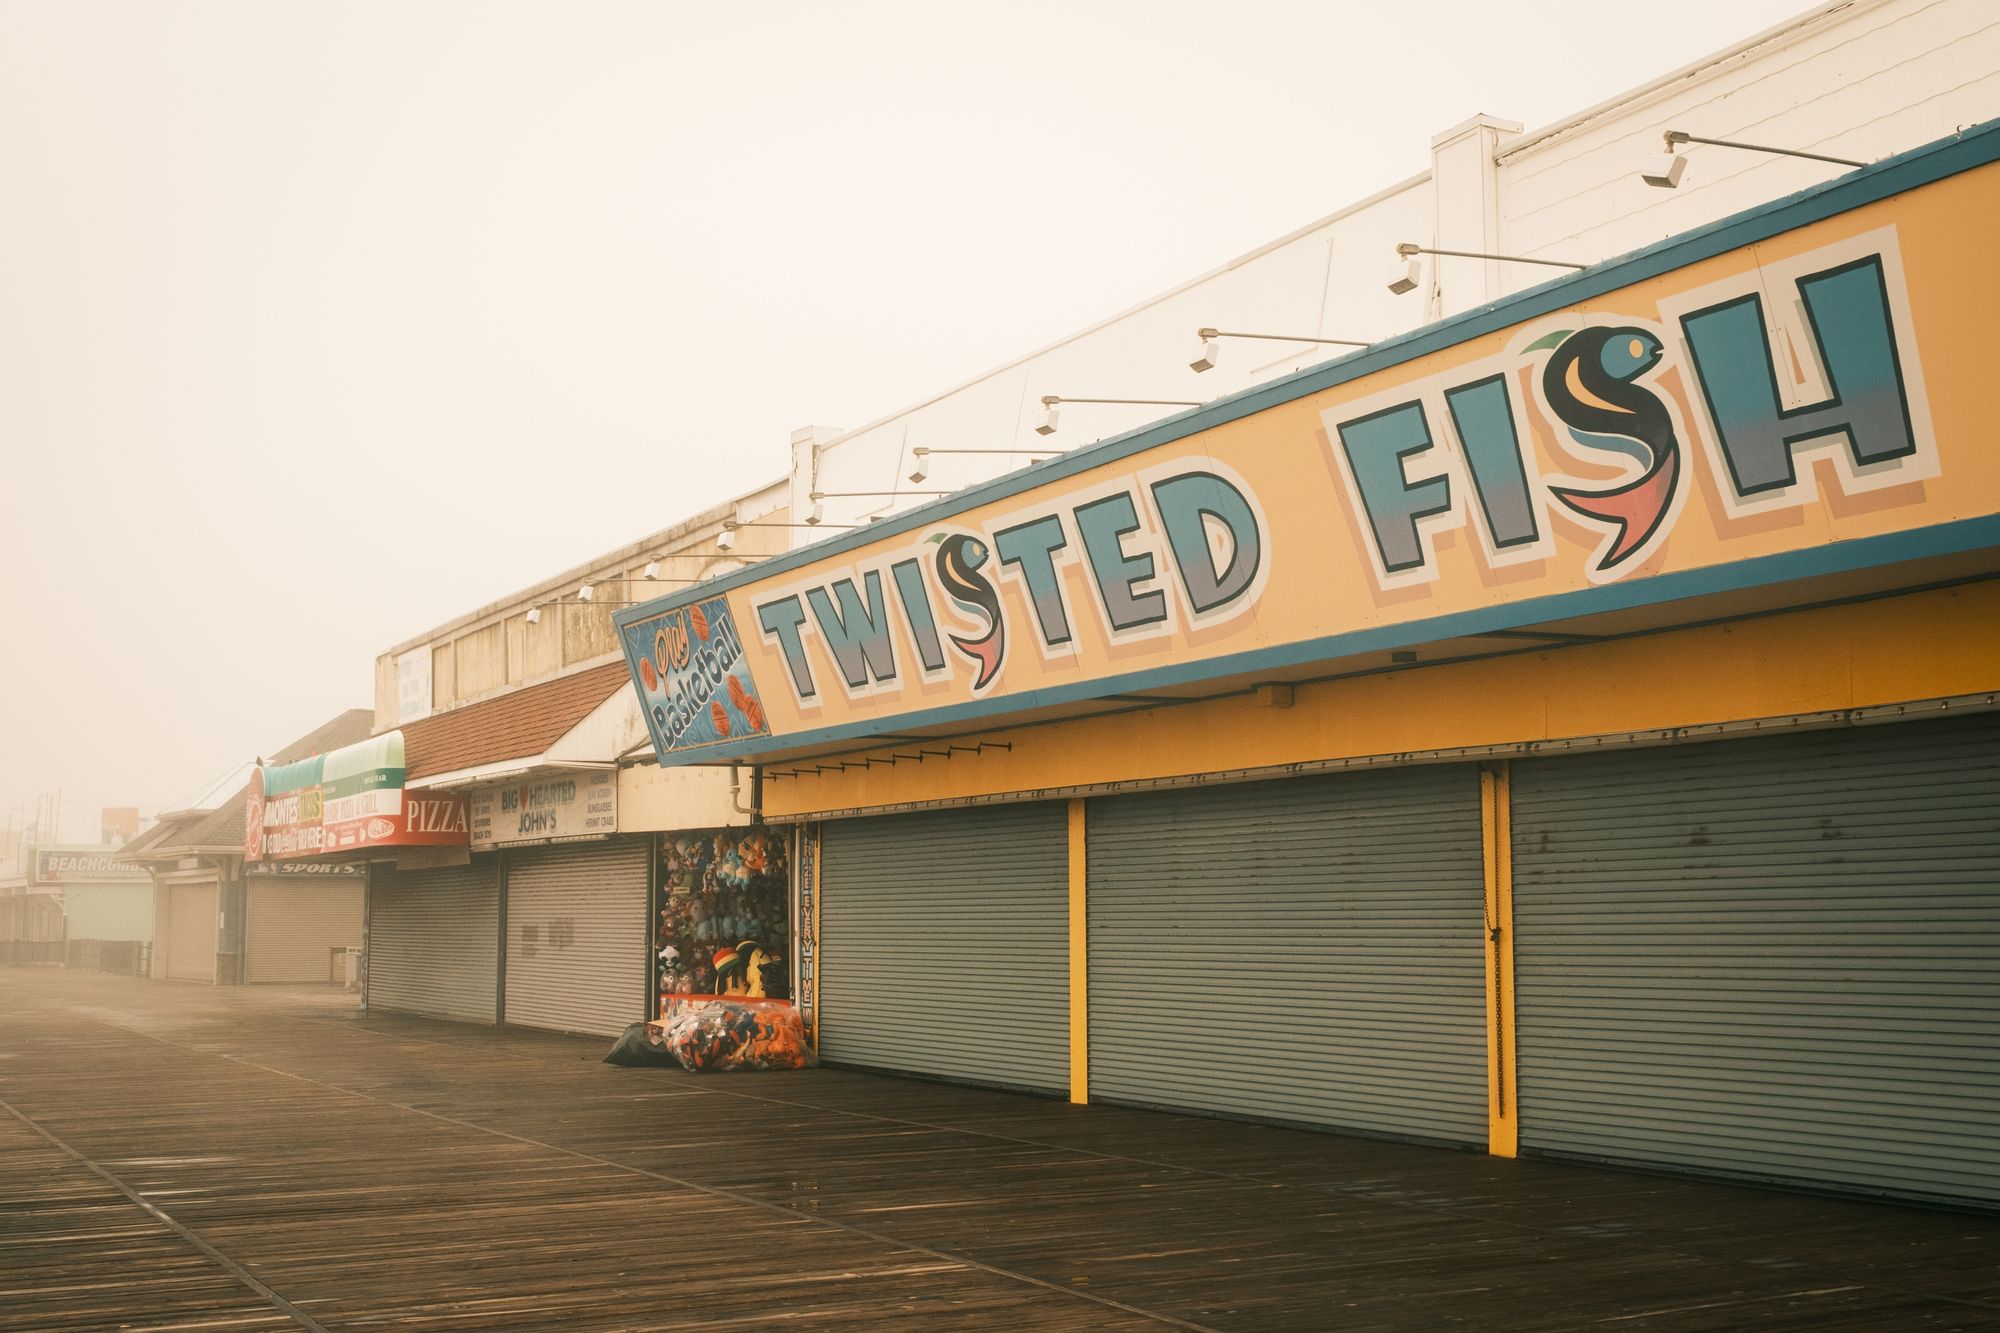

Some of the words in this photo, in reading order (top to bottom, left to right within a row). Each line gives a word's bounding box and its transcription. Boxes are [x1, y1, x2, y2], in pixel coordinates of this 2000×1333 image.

[757, 470, 1261, 698] TWISTED
[1335, 252, 1918, 573] FISH
[651, 613, 743, 750] Basketball
[406, 799, 469, 834] PIZZA
[502, 789, 519, 811] BIG
[528, 781, 577, 807] HEARTED
[518, 811, 558, 834] JOHN'S
[802, 895, 814, 953] EVERY
[802, 957, 812, 1004] TIME
